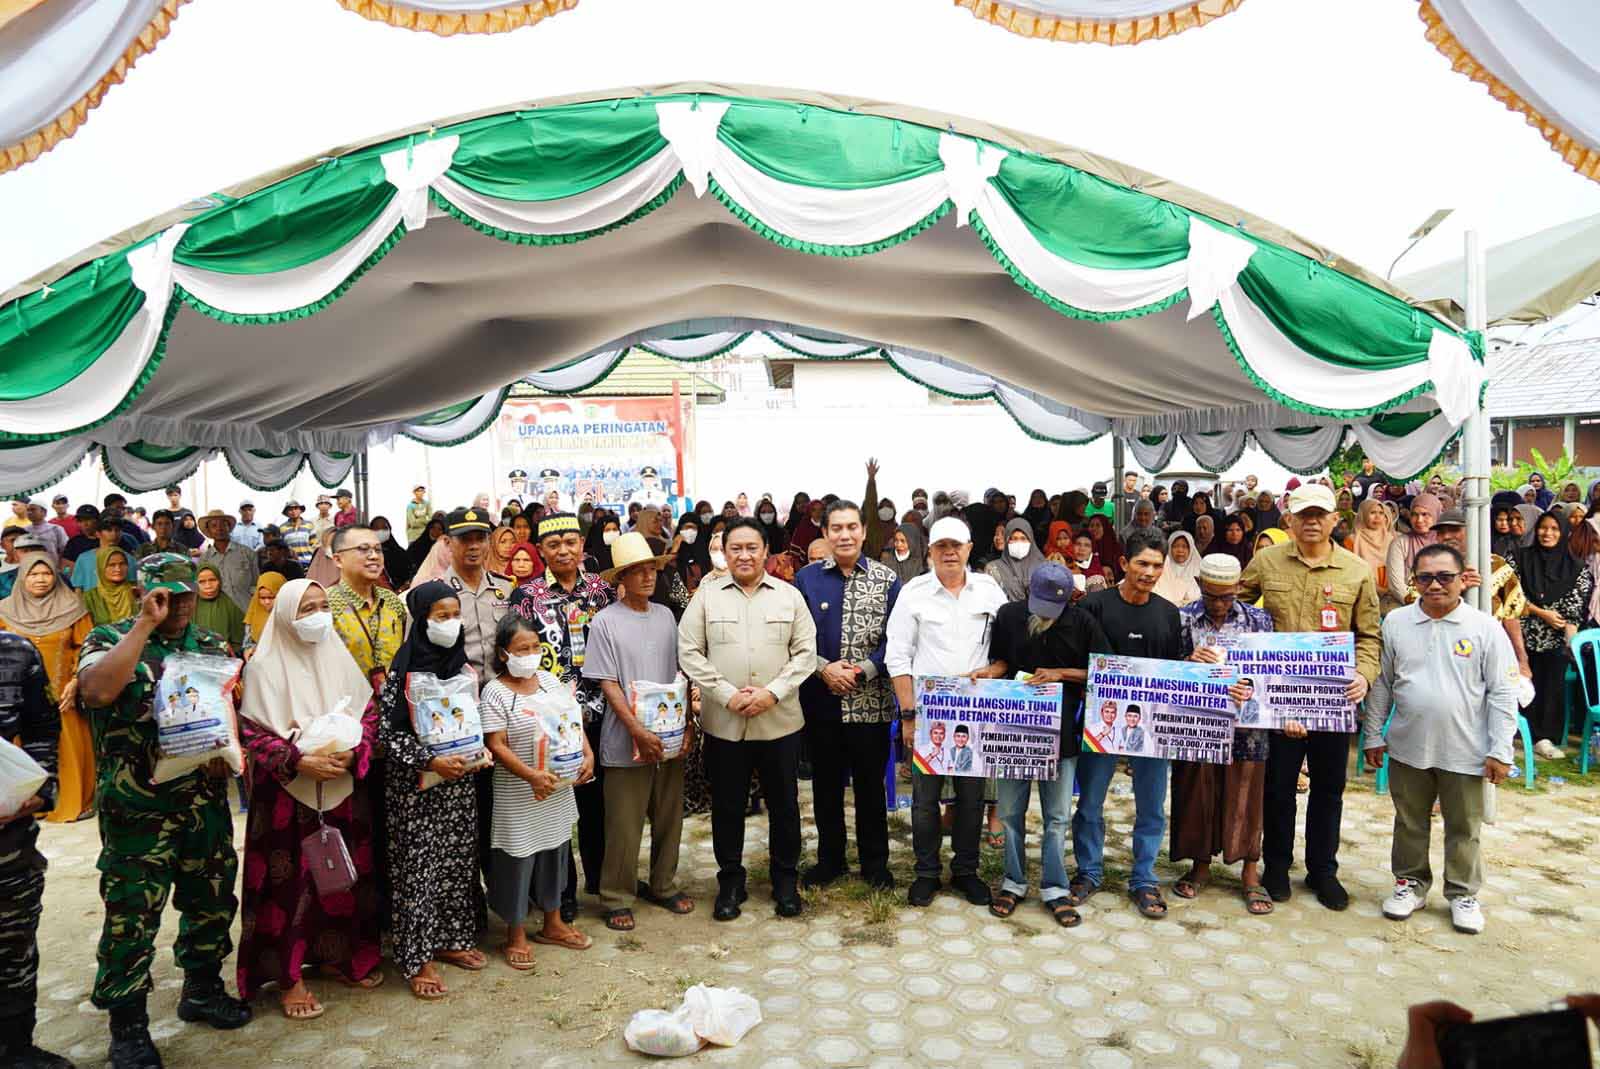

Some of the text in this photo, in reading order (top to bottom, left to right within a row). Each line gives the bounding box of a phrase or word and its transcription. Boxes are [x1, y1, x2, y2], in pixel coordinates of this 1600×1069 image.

[518, 422, 665, 436] UPACARA PERINGATAN
[1226, 650, 1349, 663] TUAN LANGSUNG TUNAI
[1242, 664, 1282, 675] BETANG
[1284, 664, 1345, 676] SEJAHTERA
[1094, 673, 1229, 695] BANTUAN LANGSUNG TUNA
[1266, 684, 1346, 695] PEMERINTAH PROVINS
[923, 694, 1057, 713] BANTUAN LANGSUNG TUNAI
[1098, 687, 1228, 709] HUMA BETANG SEJAHTERA
[1269, 696, 1346, 707] KALIMANTAN TENGAH
[926, 708, 1052, 726] HUMA BETANG SEJAHTERA
[1152, 713, 1230, 728] PEMERINTAH PROVINSI
[980, 732, 1054, 744] PEMERINTAH PROVINSI
[1154, 725, 1226, 739] KALIMANTAN TENGAH
[982, 744, 1051, 755] KALIMANTAN TENGAH
[1205, 742, 1221, 750] KPM
